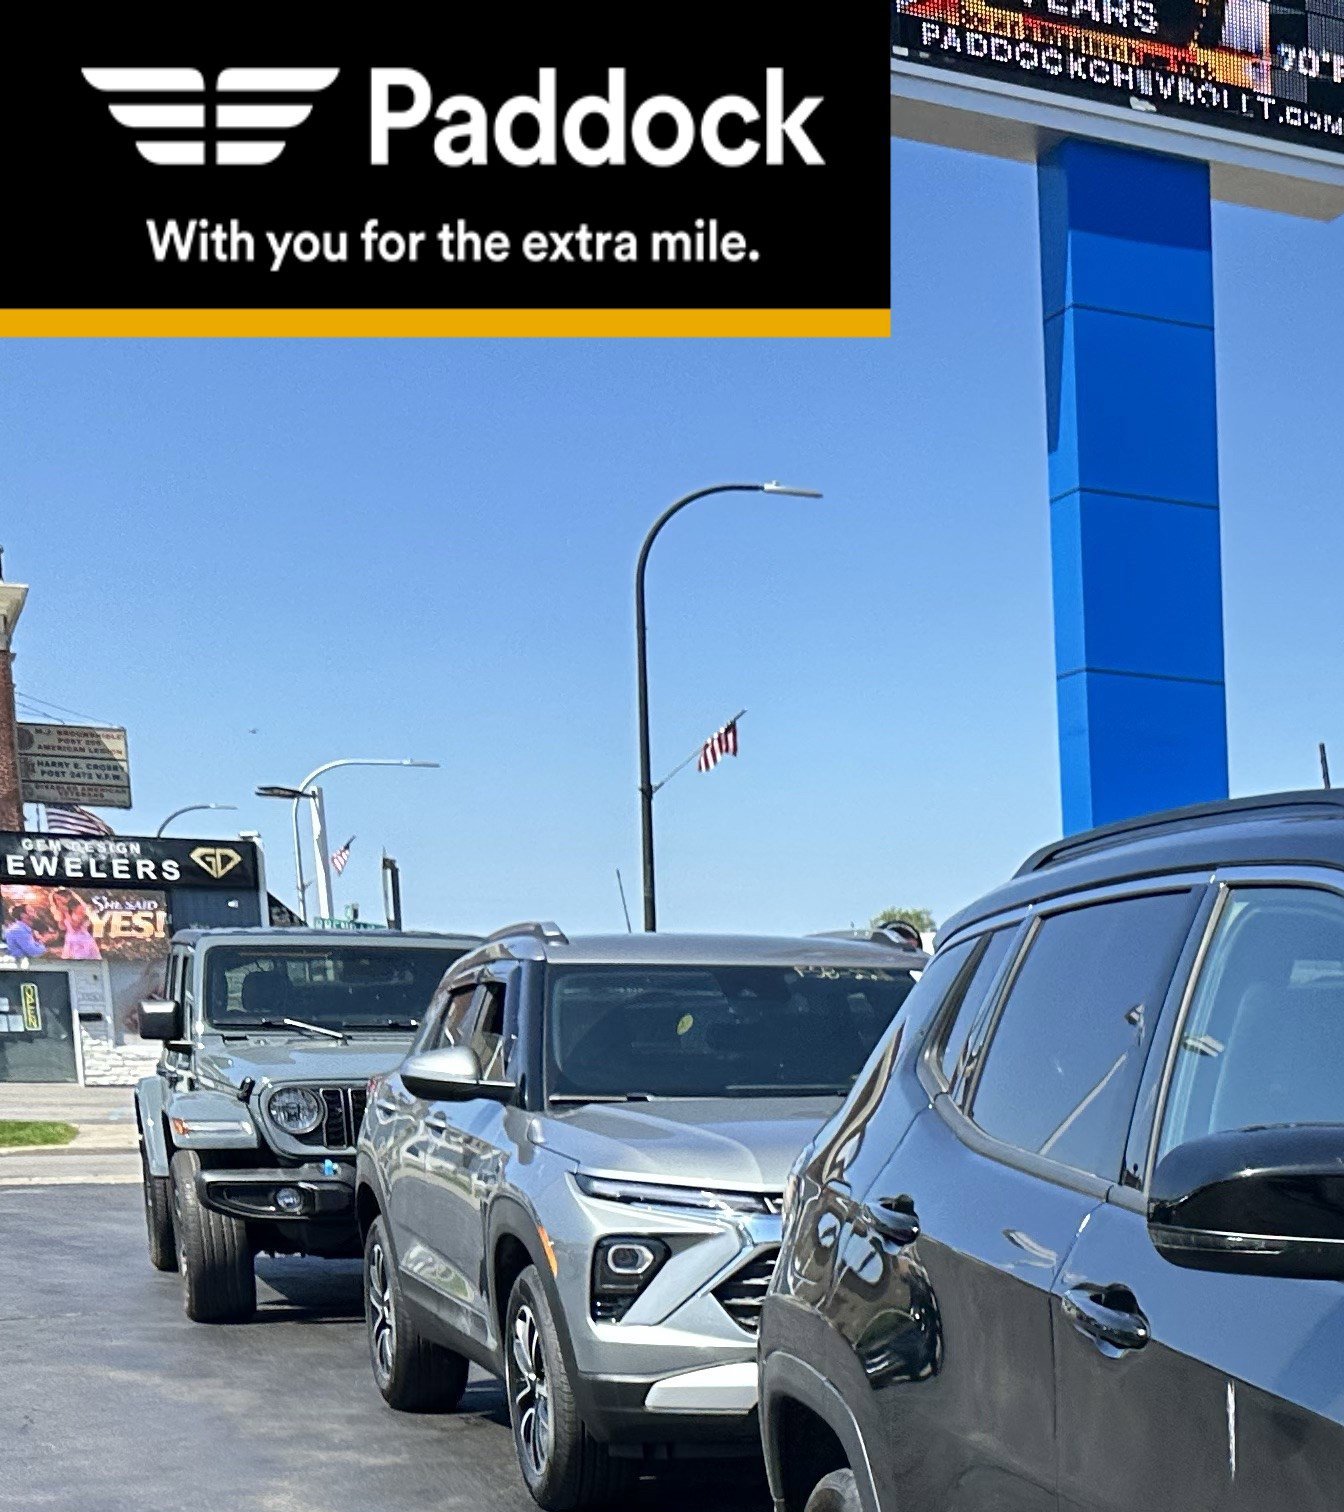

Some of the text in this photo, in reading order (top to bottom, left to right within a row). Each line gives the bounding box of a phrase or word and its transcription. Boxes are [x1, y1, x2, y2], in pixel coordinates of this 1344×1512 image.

[37, 760, 70, 768] HARRY
[40, 770, 67, 778] POST
[21, 838, 141, 855] GEM DESIGN
[86, 905, 167, 939] YES!
